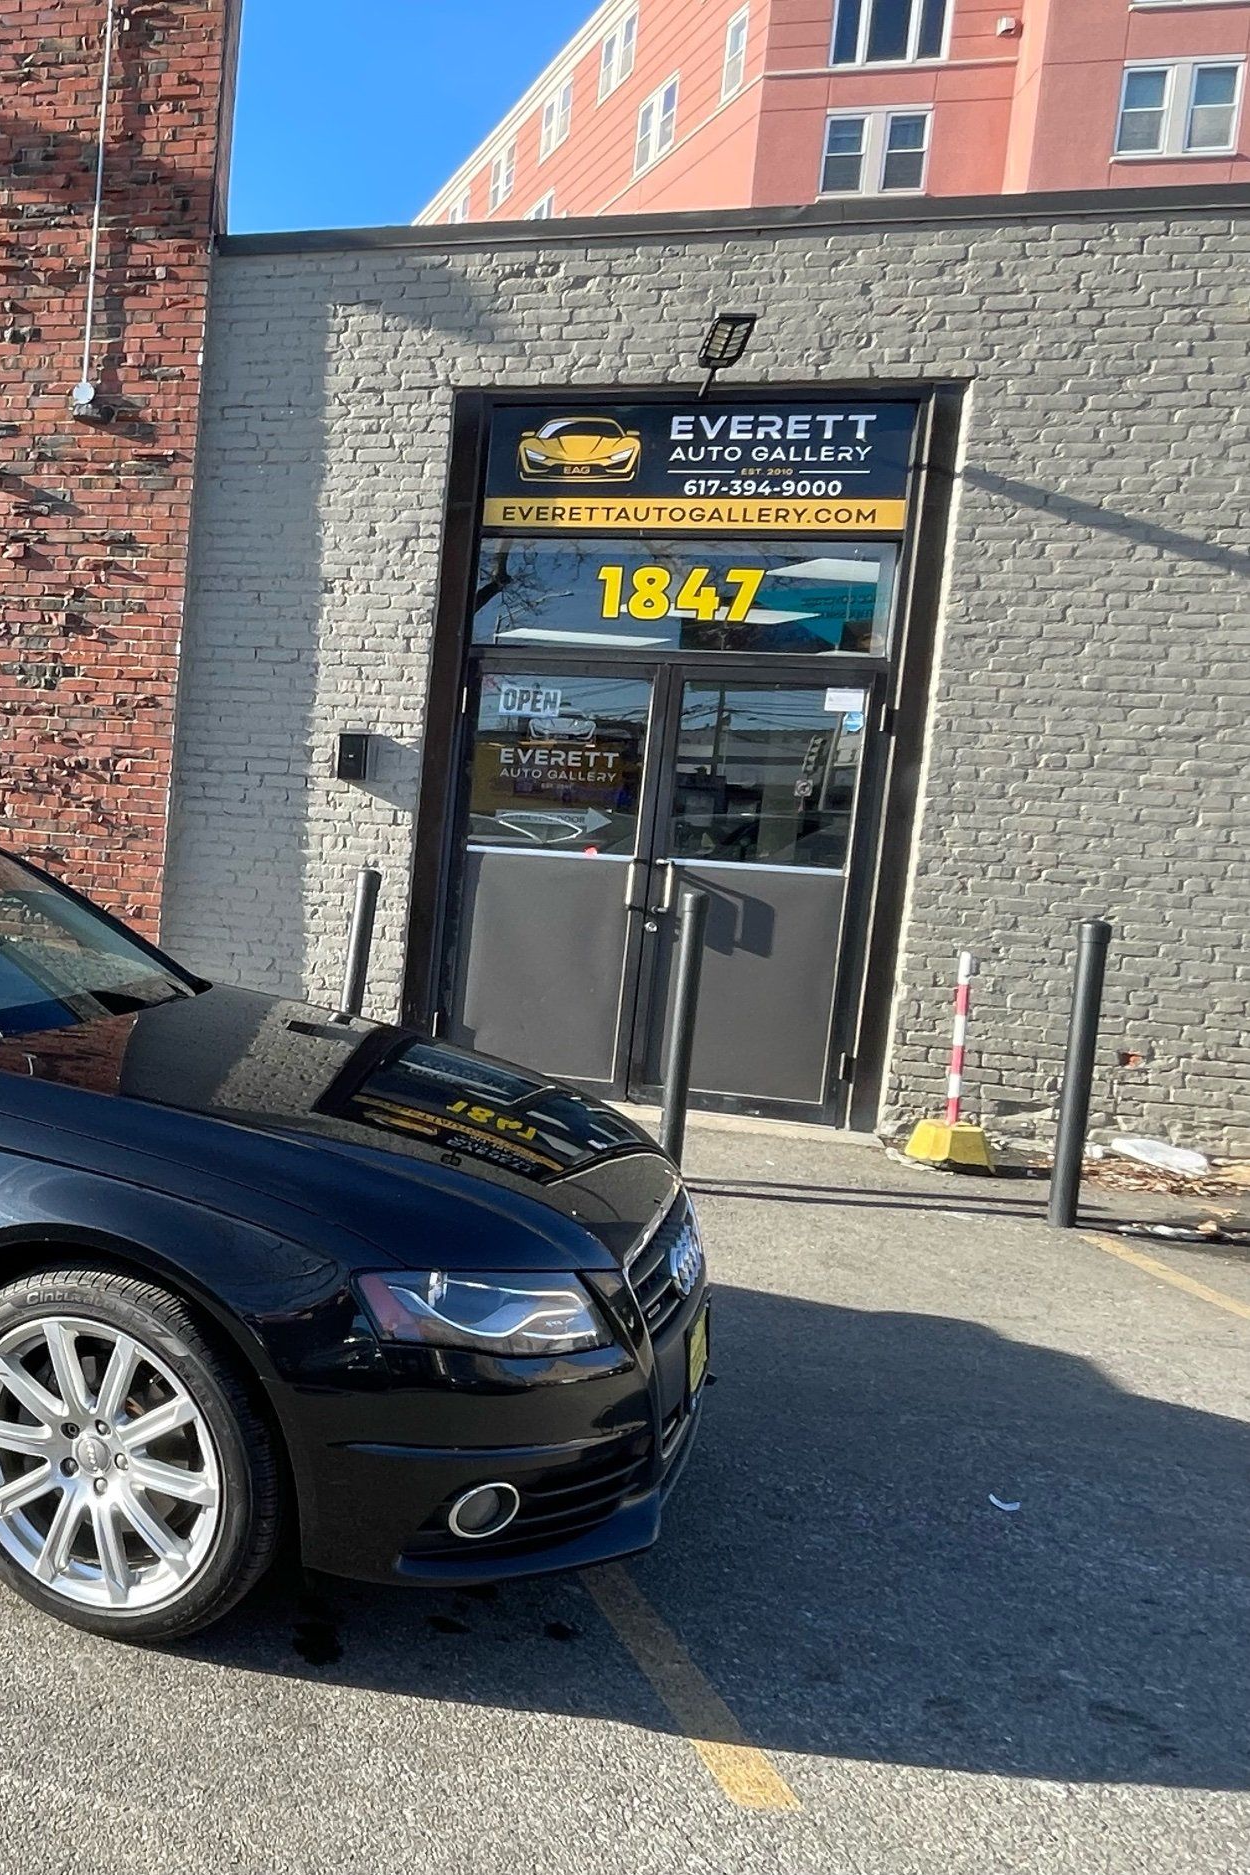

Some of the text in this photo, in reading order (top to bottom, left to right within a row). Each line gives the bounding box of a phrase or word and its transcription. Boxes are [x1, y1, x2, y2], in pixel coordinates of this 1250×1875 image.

[670, 414, 877, 441] EVERETT
[667, 446, 873, 462] AUTO GALLERY
[563, 466, 590, 475] EAG
[766, 467, 794, 476] 2010
[683, 479, 843, 497] 617-394-9000
[501, 505, 878, 525] EVERETTAUTOGALLERY.COM
[597, 565, 766, 623] 1847
[502, 688, 558, 713] OPEN
[500, 747, 620, 769] EVERETT
[499, 768, 617, 783] AUTO GALLERY
